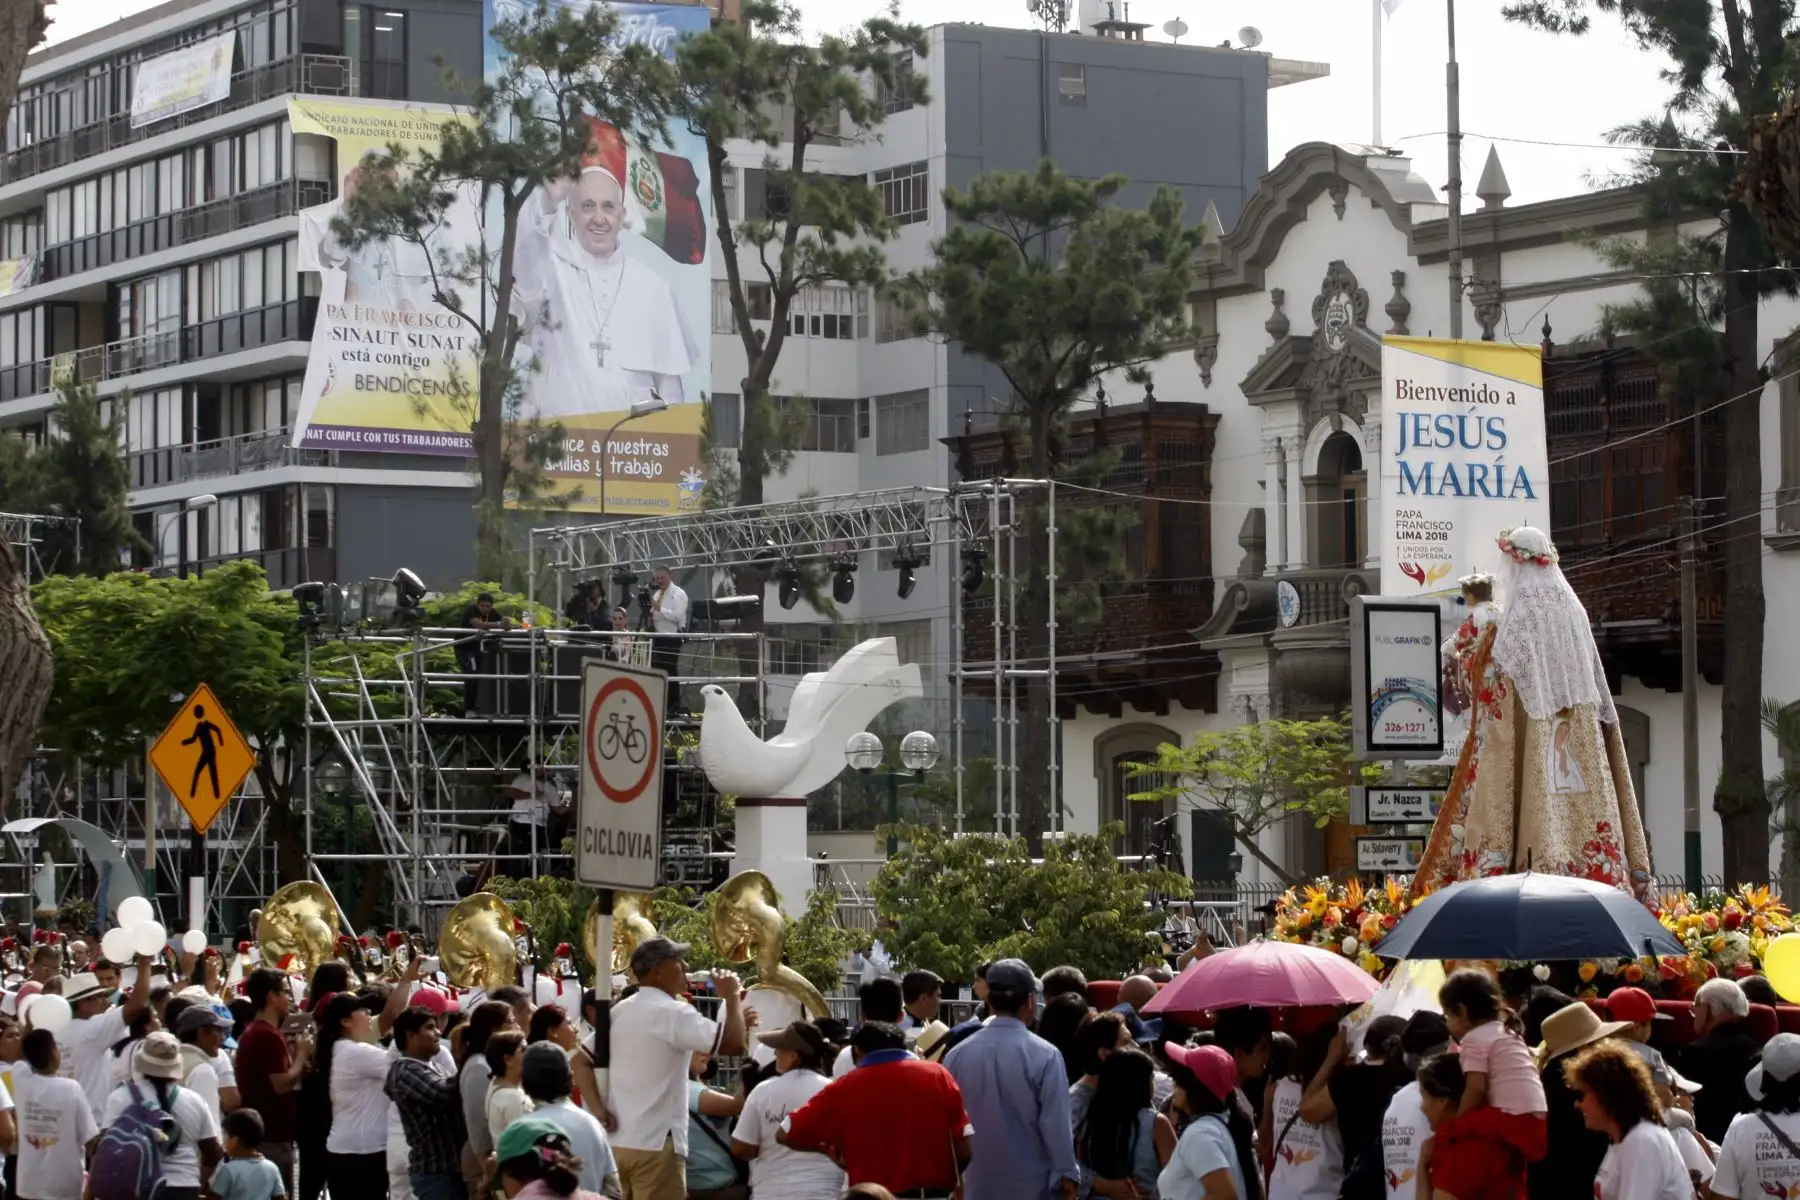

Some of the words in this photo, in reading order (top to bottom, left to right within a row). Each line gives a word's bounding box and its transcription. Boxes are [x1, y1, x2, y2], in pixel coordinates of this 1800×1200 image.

[351, 117, 398, 128] NACIONAL
[402, 121, 413, 129] DE
[326, 124, 396, 138] TRABAJADORES
[400, 130, 412, 139] DE
[354, 304, 462, 329] FRANCISCO
[332, 326, 399, 346] SINAUT
[407, 332, 465, 351] SUNAT
[342, 348, 371, 363] está
[376, 351, 430, 371] contigo
[355, 373, 471, 397] BENDÍCENOS
[1396, 379, 1500, 405] Bienvenido
[1507, 391, 1516, 405] a
[326, 430, 362, 442] CUMPLE
[363, 432, 381, 443] CON
[383, 432, 400, 444] TUS
[1395, 407, 1507, 456] JESÚS
[607, 439, 669, 456] nuestras
[543, 453, 590, 472] amilias
[610, 456, 663, 478] trabajo
[1396, 455, 1538, 500] MARÍA
[1396, 509, 1423, 519] PAPA
[1396, 520, 1453, 531] FRANCISCO
[1396, 531, 1422, 540] LIMA
[1425, 531, 1448, 541] 2018
[1375, 635, 1421, 645] PUBLIGRAFIK
[1385, 722, 1425, 733] 326-1271
[1378, 793, 1391, 805] Jr.
[1393, 793, 1422, 805] Nazca
[583, 826, 653, 861] CICLOVIA
[1371, 842, 1402, 856] Salaverry
[1756, 1152, 1784, 1161] LIMA
